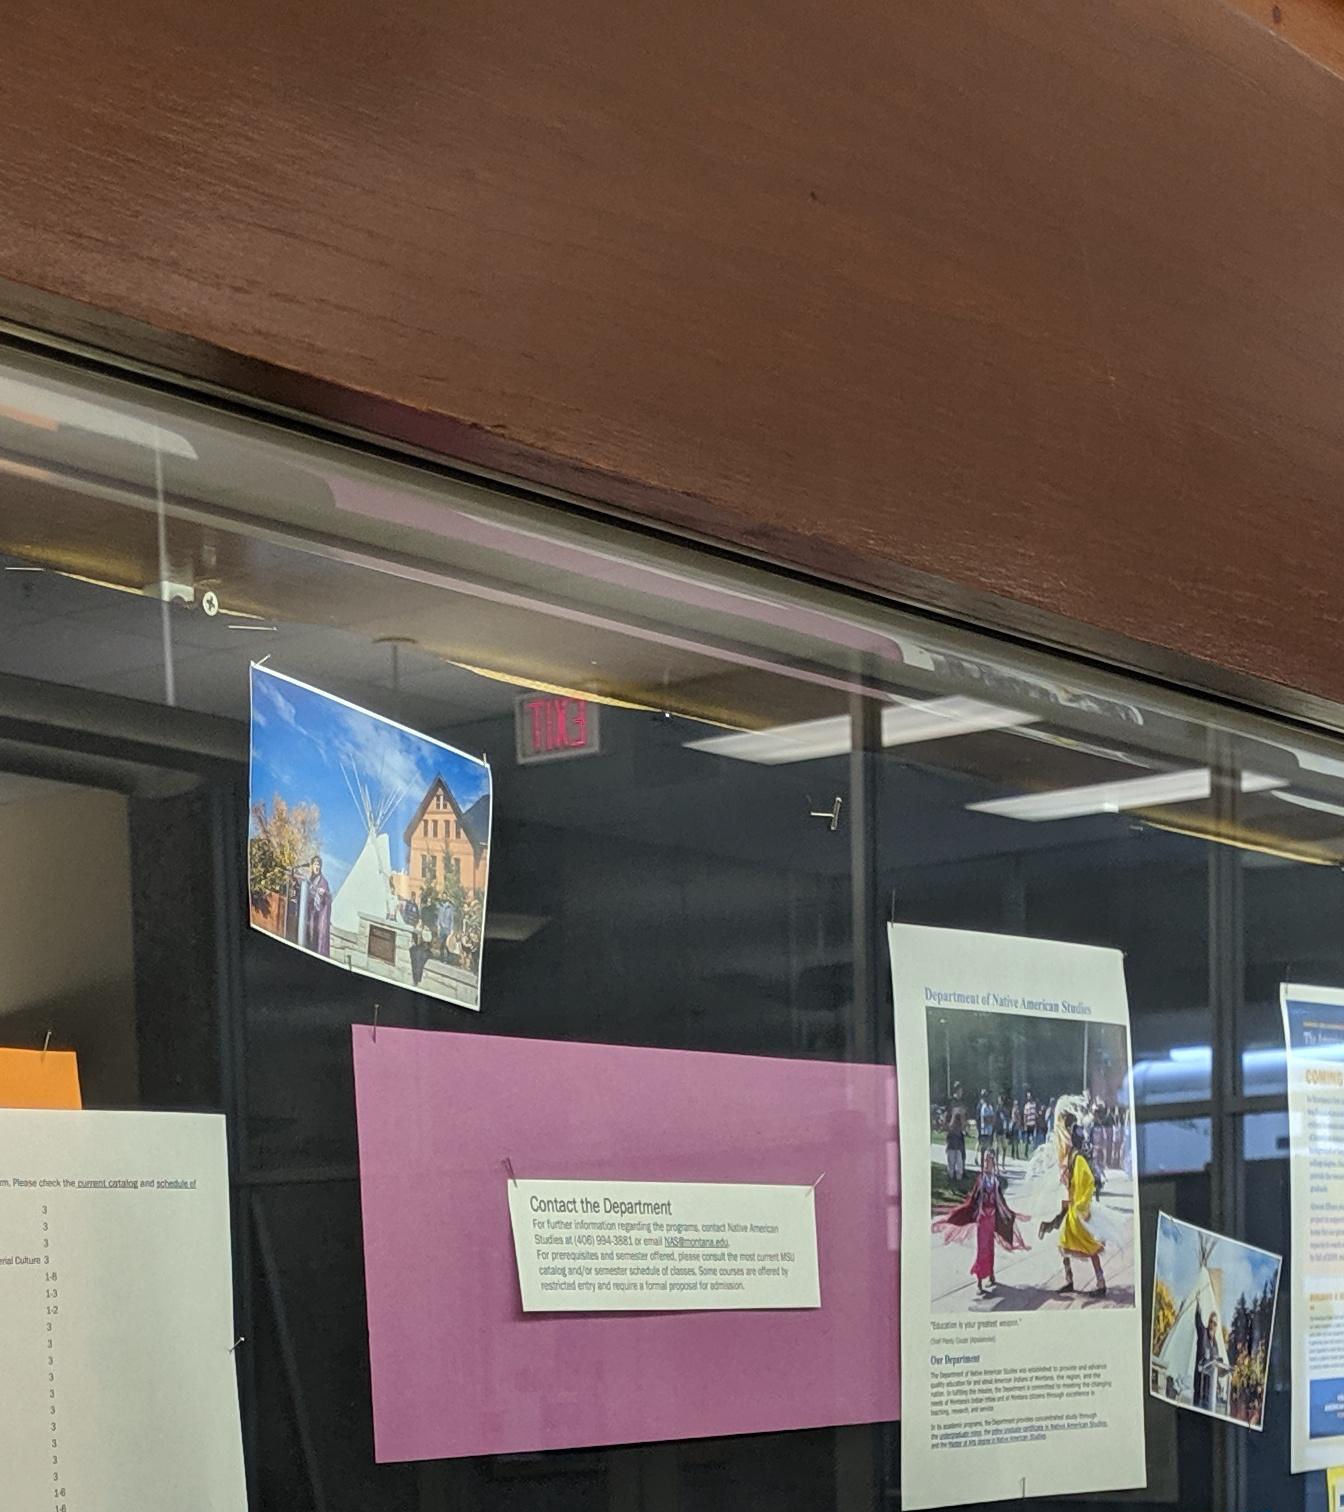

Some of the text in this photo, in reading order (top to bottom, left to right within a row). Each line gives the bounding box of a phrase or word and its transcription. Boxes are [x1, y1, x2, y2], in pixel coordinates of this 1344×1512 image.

[40, 1204, 48, 1215] 3
[529, 1194, 672, 1217] Contact the Department
[533, 1233, 564, 1245] Studies
[564, 1234, 573, 1245] at
[633, 1236, 642, 1246] or
[642, 1235, 663, 1246] email
[45, 1321, 52, 1332] 3
